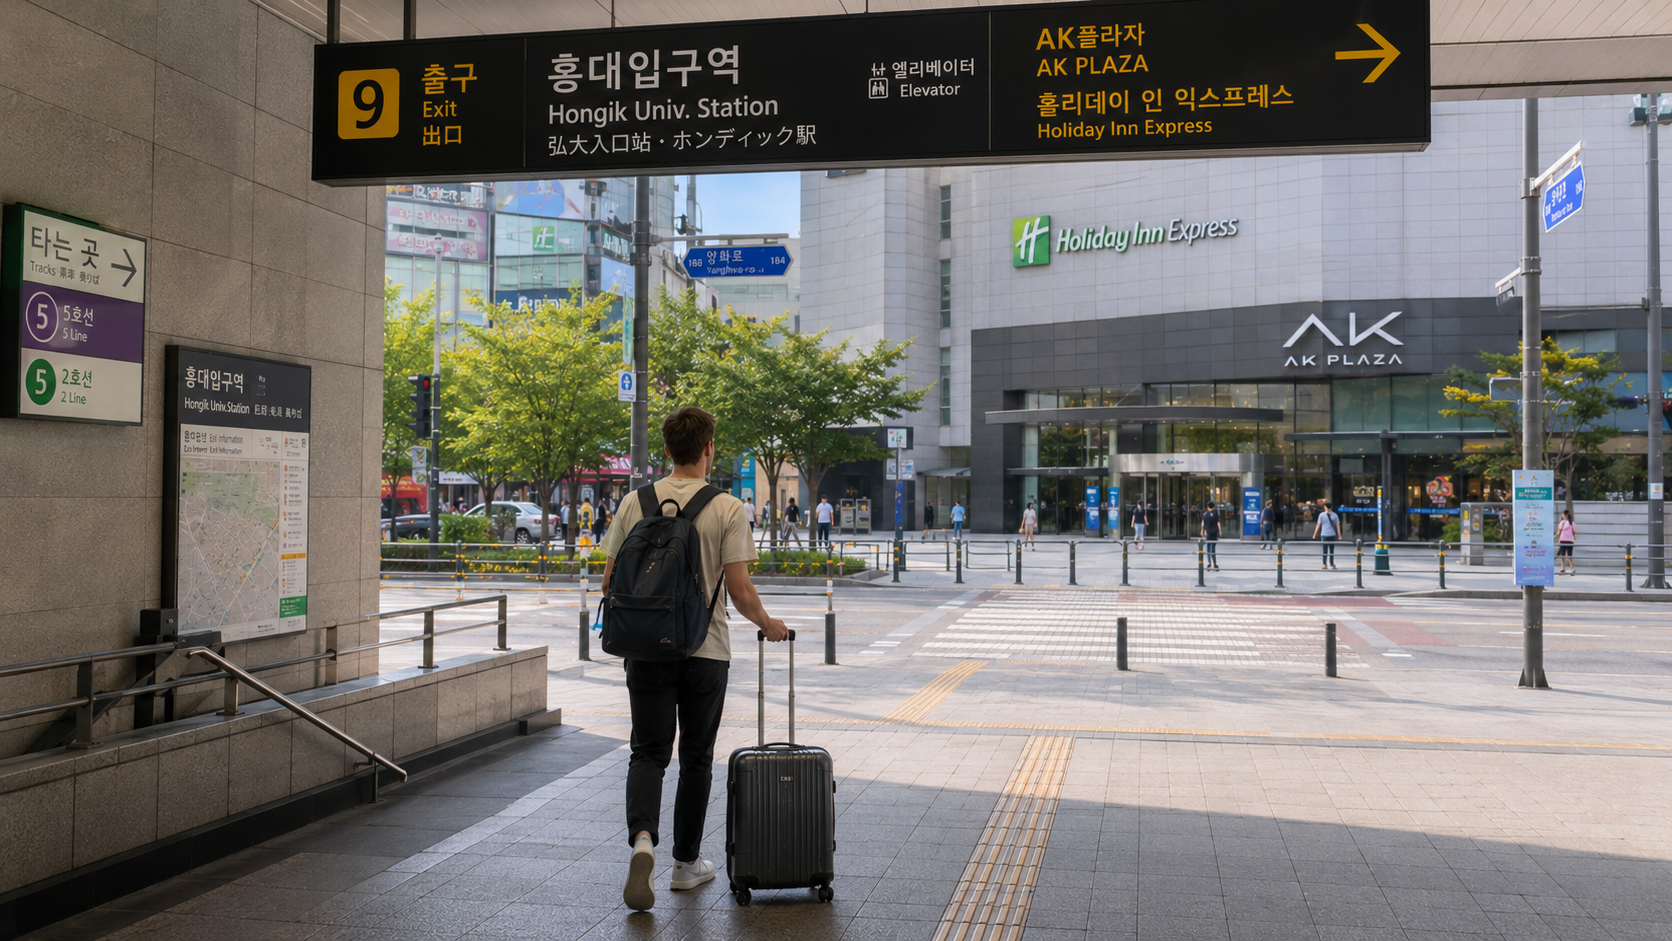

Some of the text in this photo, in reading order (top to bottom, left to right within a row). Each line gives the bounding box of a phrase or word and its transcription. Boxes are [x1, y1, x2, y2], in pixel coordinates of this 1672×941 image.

[1036, 23, 1146, 50] AK플라자
[548, 45, 739, 93] 홍대입구역
[892, 57, 975, 79] 엘리베이터
[1036, 54, 1149, 77] AK PLAZA
[421, 63, 478, 95] 출구
[900, 83, 961, 98] Elevator
[353, 79, 384, 129] 9
[423, 100, 457, 118] Exit
[549, 95, 779, 128] Hongik Univ. Station
[1037, 84, 1294, 117] 홀리데이 인 익스프레스
[423, 124, 462, 146] 出口
[1038, 119, 1213, 140] Holiday Inn Express
[31, 226, 99, 269] 타는 곳
[1056, 218, 1239, 252] Holiday Inn Express
[36, 303, 48, 329] 5
[63, 305, 93, 327] 5호선
[62, 327, 87, 342] 5 Line
[1282, 311, 1404, 348] AK
[1284, 354, 1402, 367] AK PLAZA
[35, 368, 47, 395] 5
[61, 391, 86, 405] 2 Line
